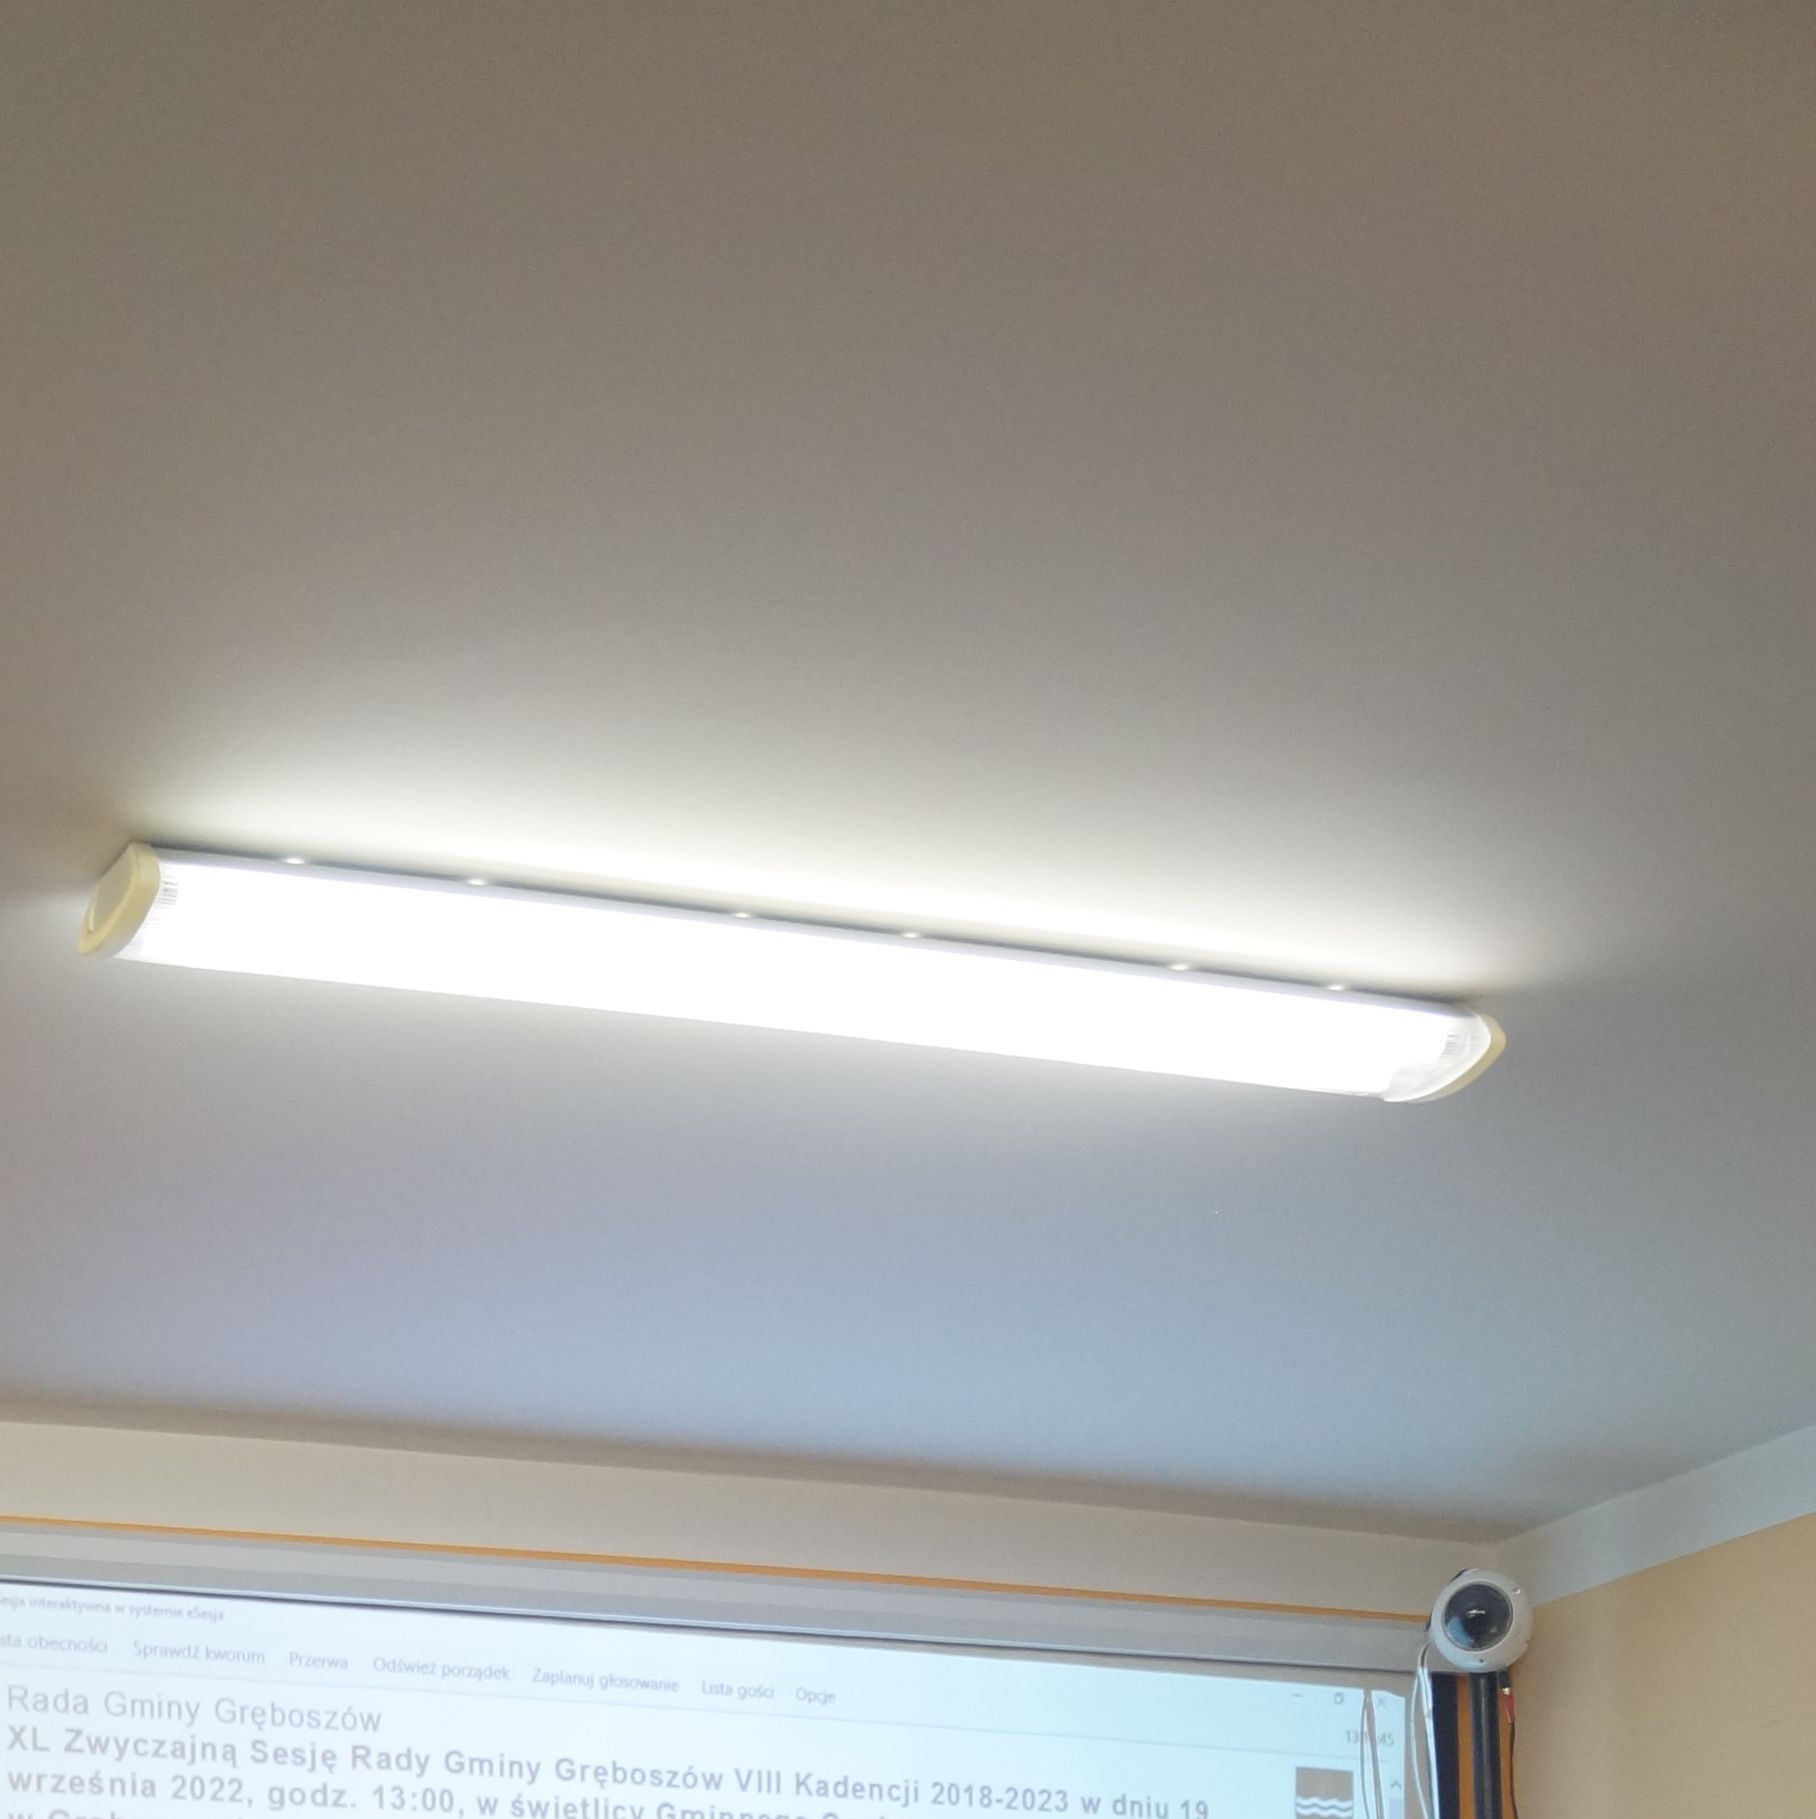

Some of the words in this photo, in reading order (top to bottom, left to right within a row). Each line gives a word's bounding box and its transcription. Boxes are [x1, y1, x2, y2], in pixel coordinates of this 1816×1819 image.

[27, 1635, 107, 1654] obecności
[205, 1645, 265, 1663] kworum
[289, 1651, 348, 1670] Przerwa
[373, 1657, 437, 1676] Odśwież
[442, 1662, 511, 1682] porządek
[532, 1667, 594, 1690] Zaplanuj
[599, 1673, 679, 1693] głosowanie
[702, 1680, 733, 1697] Lista
[738, 1683, 775, 1701] gości
[795, 1686, 836, 1704] Opcje
[7, 1684, 89, 1715] Rada
[104, 1690, 200, 1727] Gminy
[214, 1697, 382, 1732] Gręboszów
[7, 1725, 51, 1752] XL
[64, 1728, 238, 1768] Zwyczajną
[250, 1739, 337, 1774] Sesję
[351, 1745, 430, 1778] Rady
[444, 1750, 541, 1785] Gminy
[555, 1758, 724, 1791] Gręboszów
[734, 1768, 782, 1795] VIII
[795, 1772, 919, 1808] Kadencji
[931, 1782, 1069, 1813] 2018-2023
[1081, 1796, 1101, 1814] w
[1112, 1793, 1169, 1819] dniu
[8, 1770, 156, 1799] września
[171, 1774, 253, 1807] 2022,
[268, 1783, 357, 1811] godz.
[372, 1785, 465, 1818] 13:00,
[476, 1797, 499, 1817] w
